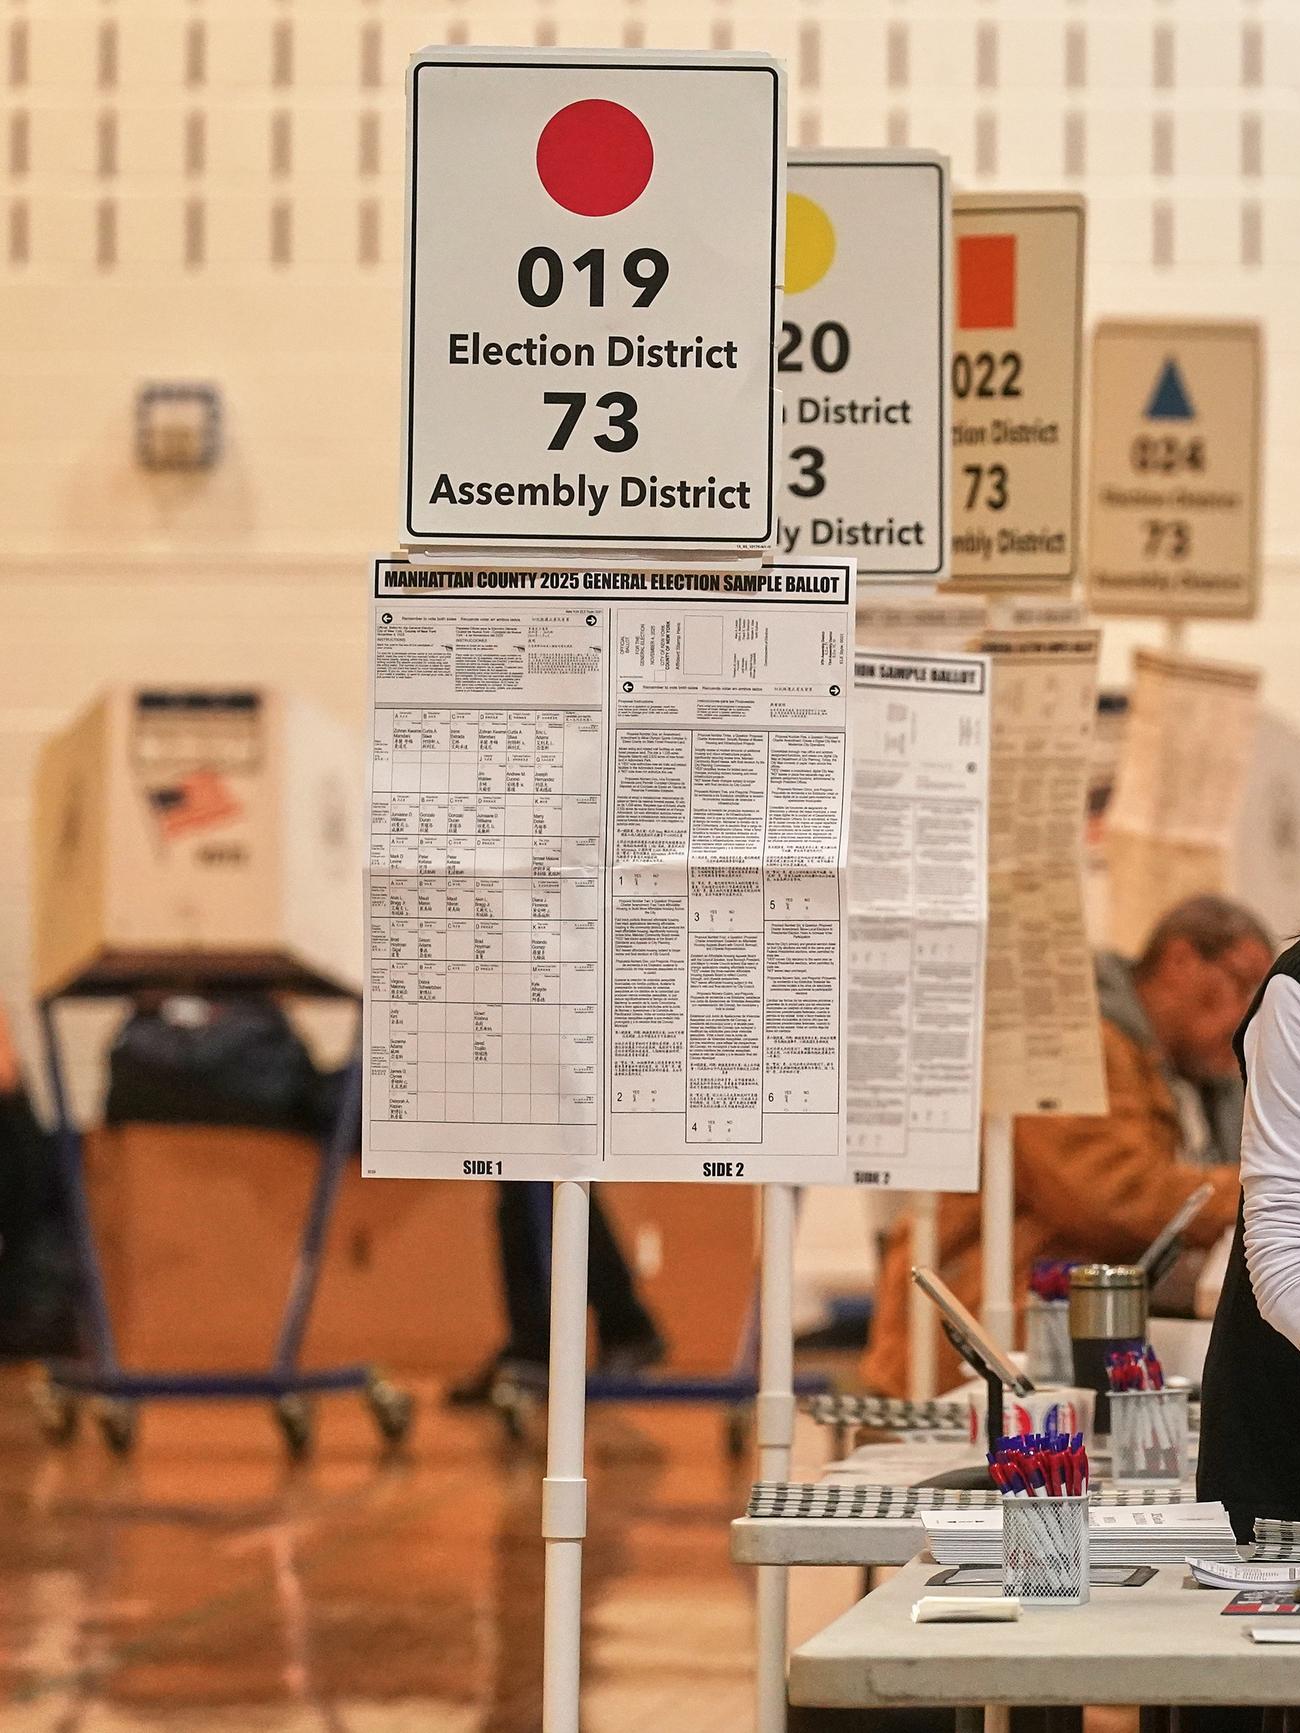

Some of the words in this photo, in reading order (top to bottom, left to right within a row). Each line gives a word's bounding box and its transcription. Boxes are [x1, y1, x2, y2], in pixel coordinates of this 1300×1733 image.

[518, 248, 669, 309] 019
[449, 335, 597, 367] Election
[608, 336, 738, 369] District
[778, 321, 850, 373] 20
[952, 352, 1023, 399] 022
[799, 398, 911, 424] District
[543, 392, 640, 453] 73
[991, 423, 1059, 444] District
[788, 447, 825, 497] 3
[429, 474, 608, 516] Assembly
[619, 477, 751, 510] District
[963, 464, 1009, 511] 73
[812, 518, 924, 546] District
[384, 571, 471, 588] MANHATTAN
[477, 572, 537, 588] COUNTY
[540, 573, 579, 589] 2025
[583, 573, 647, 590] GENERAL
[651, 574, 720, 591] ELECTION
[724, 575, 782, 592] SAMPLE
[786, 577, 839, 593] BALLOT
[881, 665, 927, 682] SAMPLE
[931, 668, 976, 685] BALLOT
[619, 876, 623, 886] 1
[770, 901, 776, 909] 5
[694, 913, 700, 921] 3
[617, 1093, 623, 1102] 2
[768, 1093, 774, 1102] 6
[692, 1123, 697, 1131] 4
[463, 1161, 493, 1175] SIDE
[496, 1161, 502, 1175] 1
[703, 1163, 732, 1176] SIDE
[736, 1163, 744, 1176] 2
